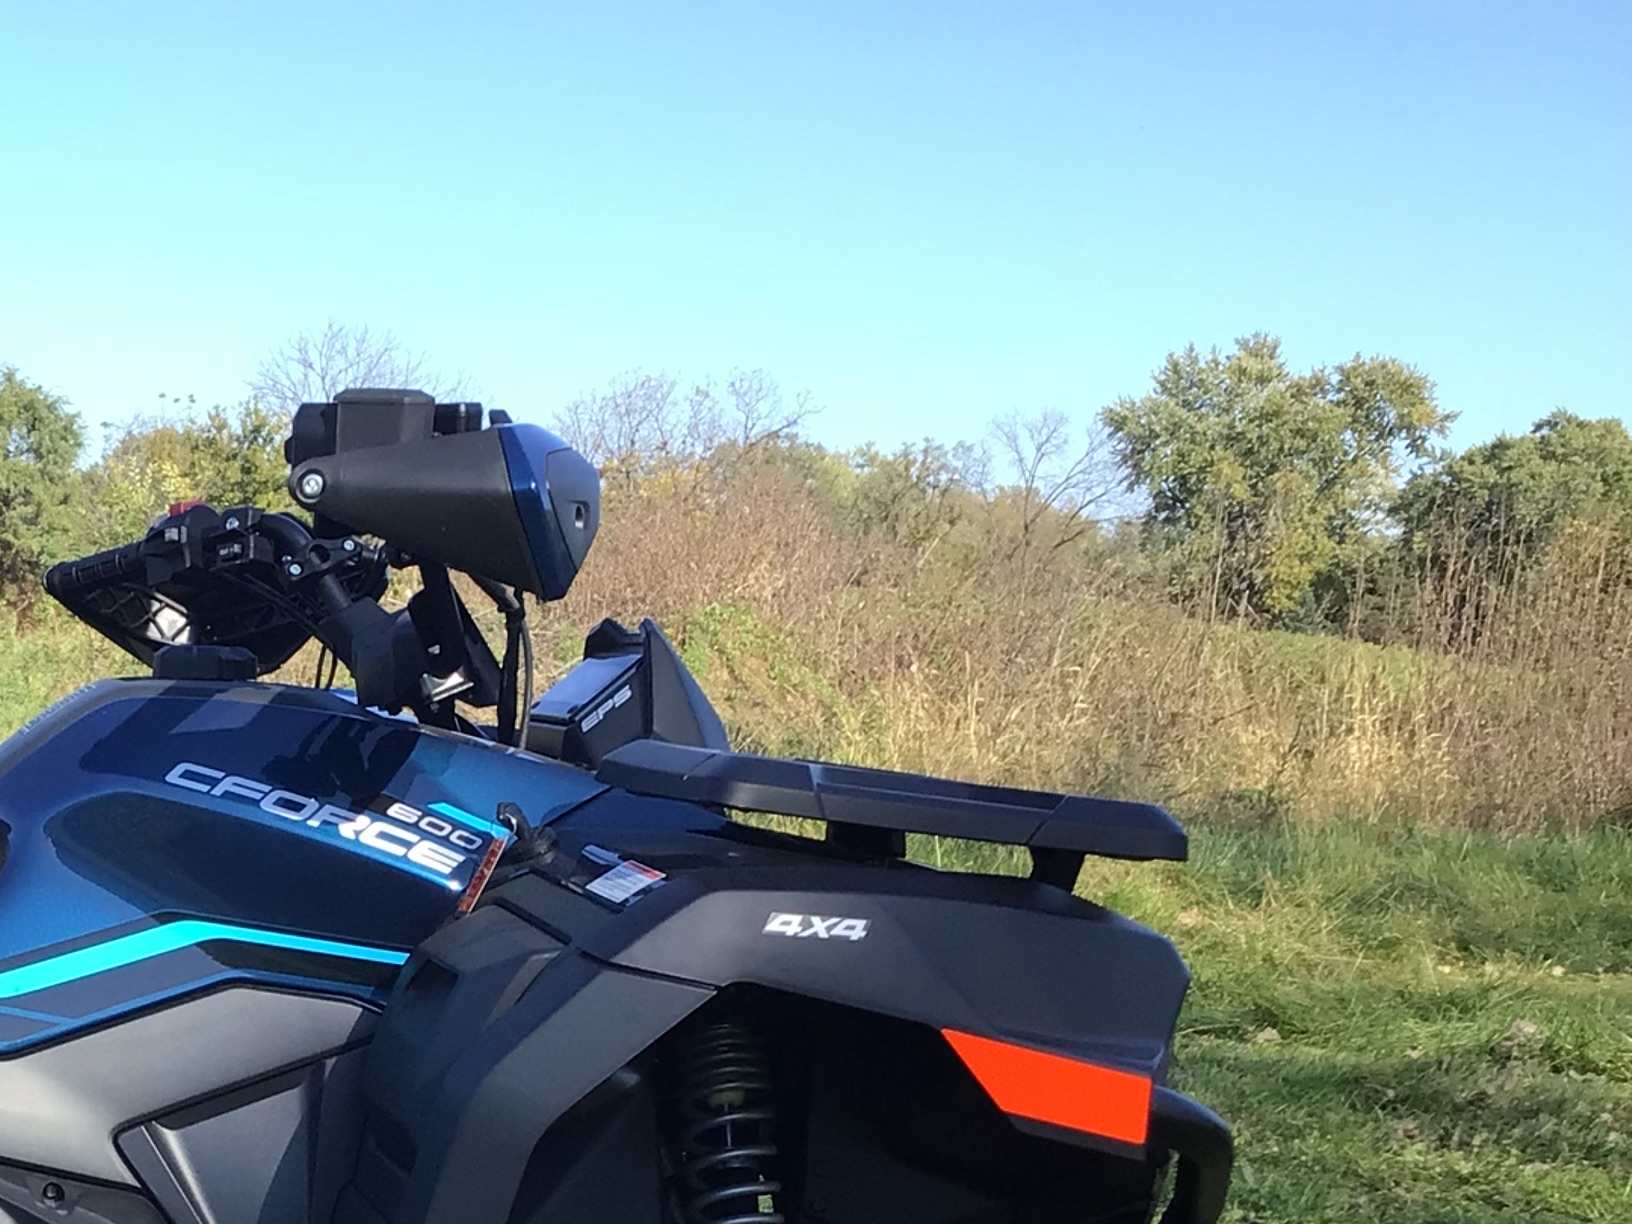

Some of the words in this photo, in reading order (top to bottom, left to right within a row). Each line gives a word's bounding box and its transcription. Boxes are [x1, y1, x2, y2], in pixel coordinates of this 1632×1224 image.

[580, 685, 633, 733] EPS
[164, 762, 467, 875] CFORCE
[386, 802, 483, 850] 600
